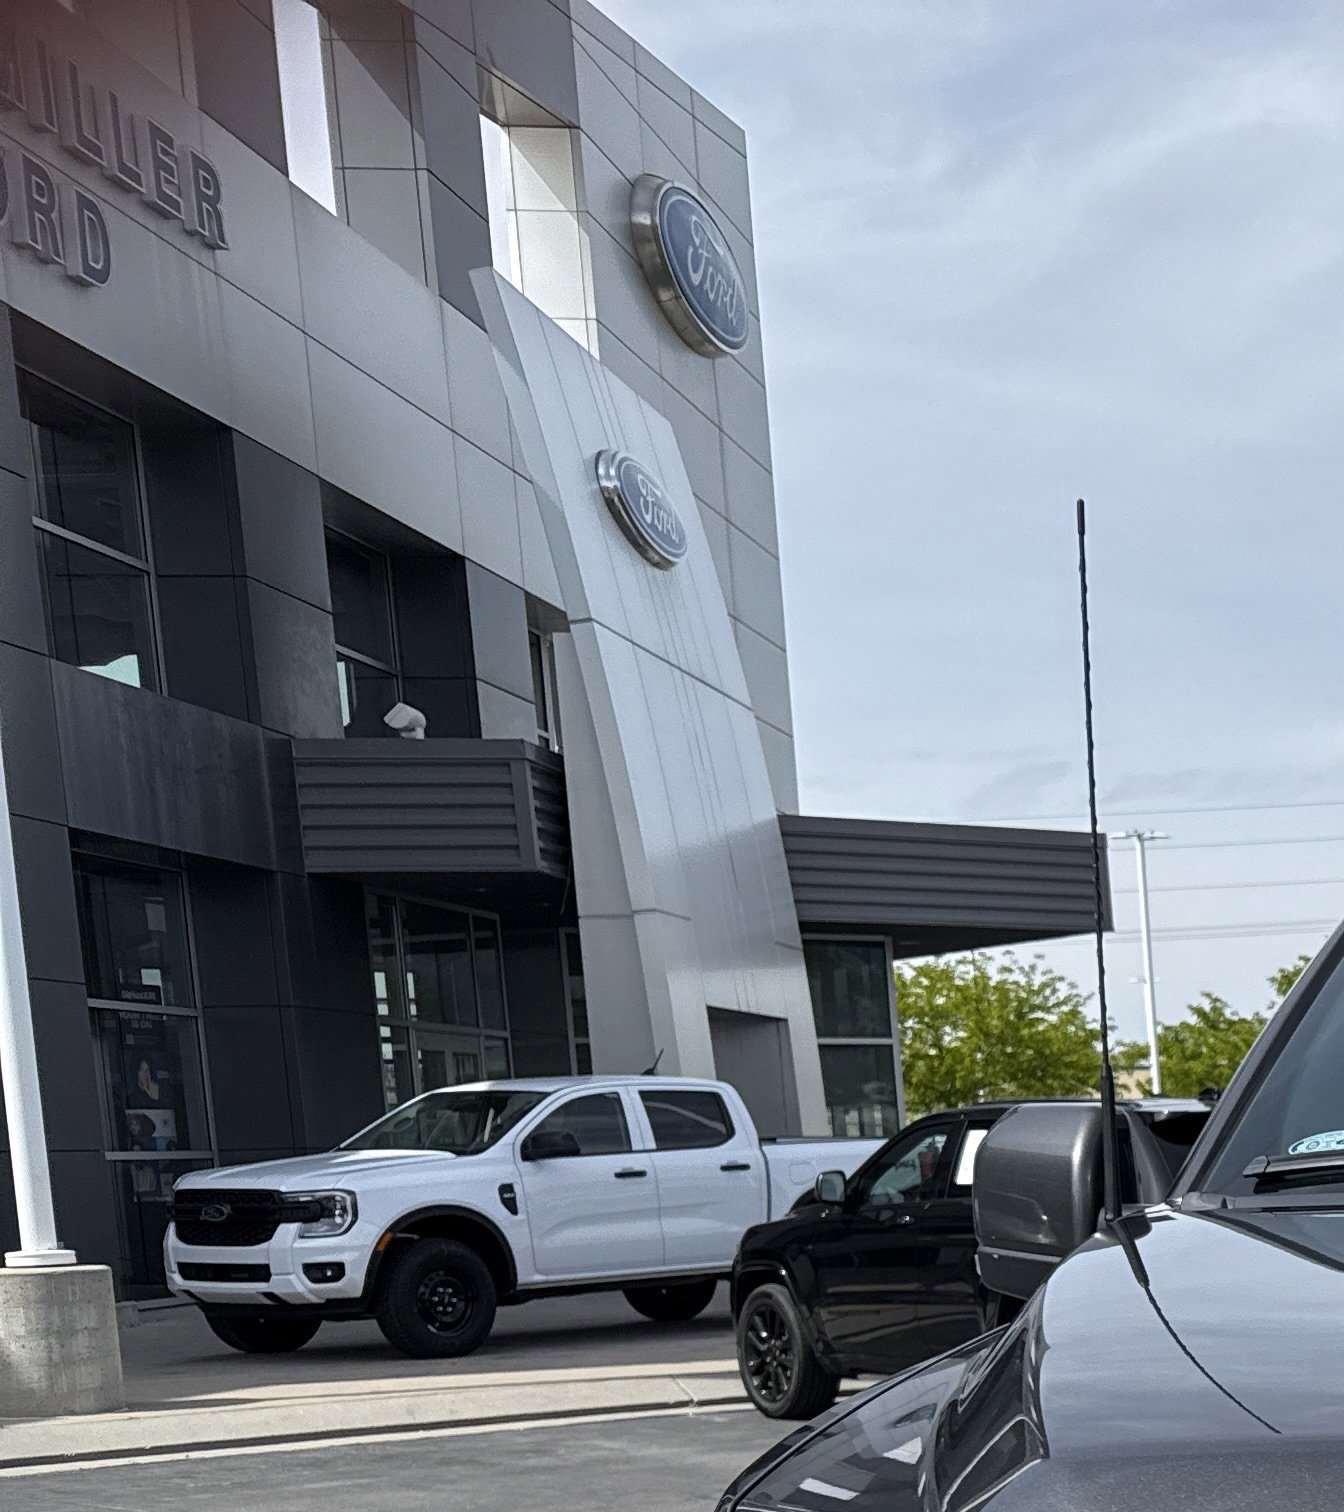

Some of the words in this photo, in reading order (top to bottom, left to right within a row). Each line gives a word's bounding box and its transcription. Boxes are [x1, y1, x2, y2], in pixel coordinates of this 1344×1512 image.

[0, 147, 111, 287] RD
[687, 214, 738, 327] Ford
[637, 473, 680, 545] Ford
